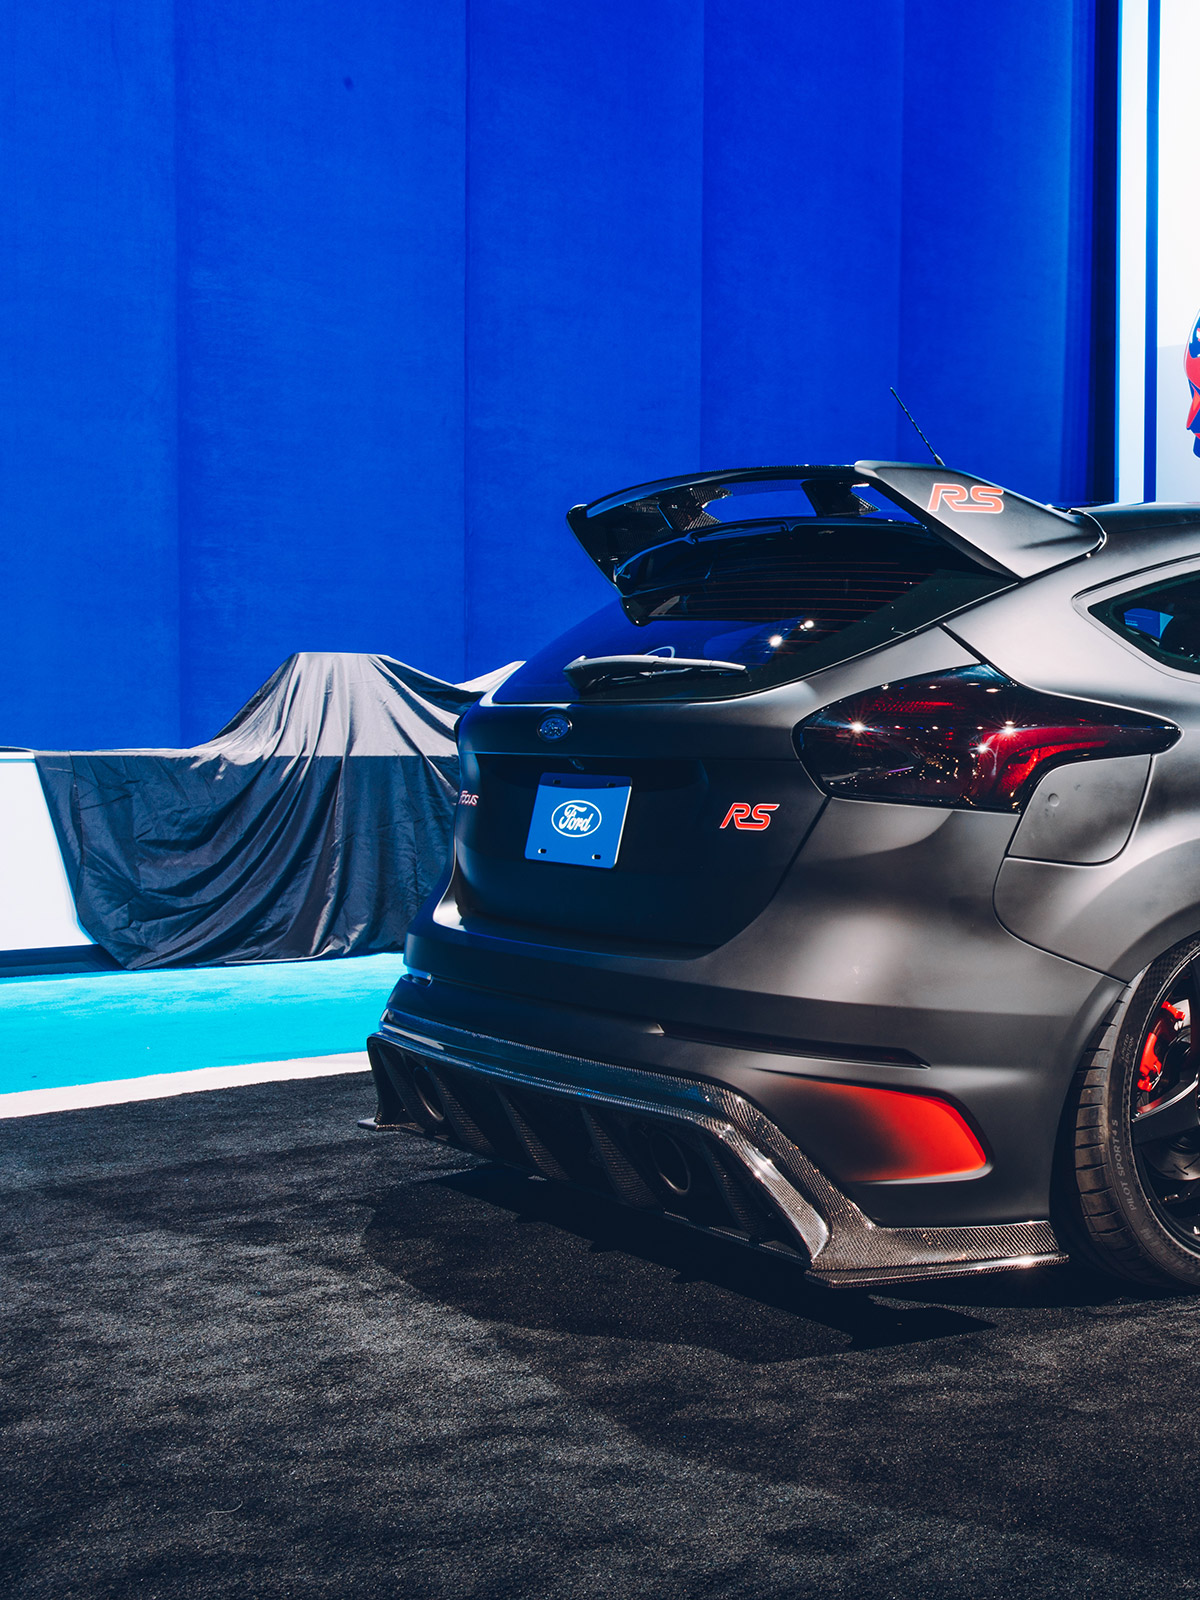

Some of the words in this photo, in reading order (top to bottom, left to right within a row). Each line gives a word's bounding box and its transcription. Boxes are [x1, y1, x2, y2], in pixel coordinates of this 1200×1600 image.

[927, 482, 1005, 514] RS
[558, 804, 595, 832] Ford
[719, 802, 780, 831] RS
[1112, 1138, 1126, 1177] SPORT
[1120, 1180, 1138, 1211] PILOT
